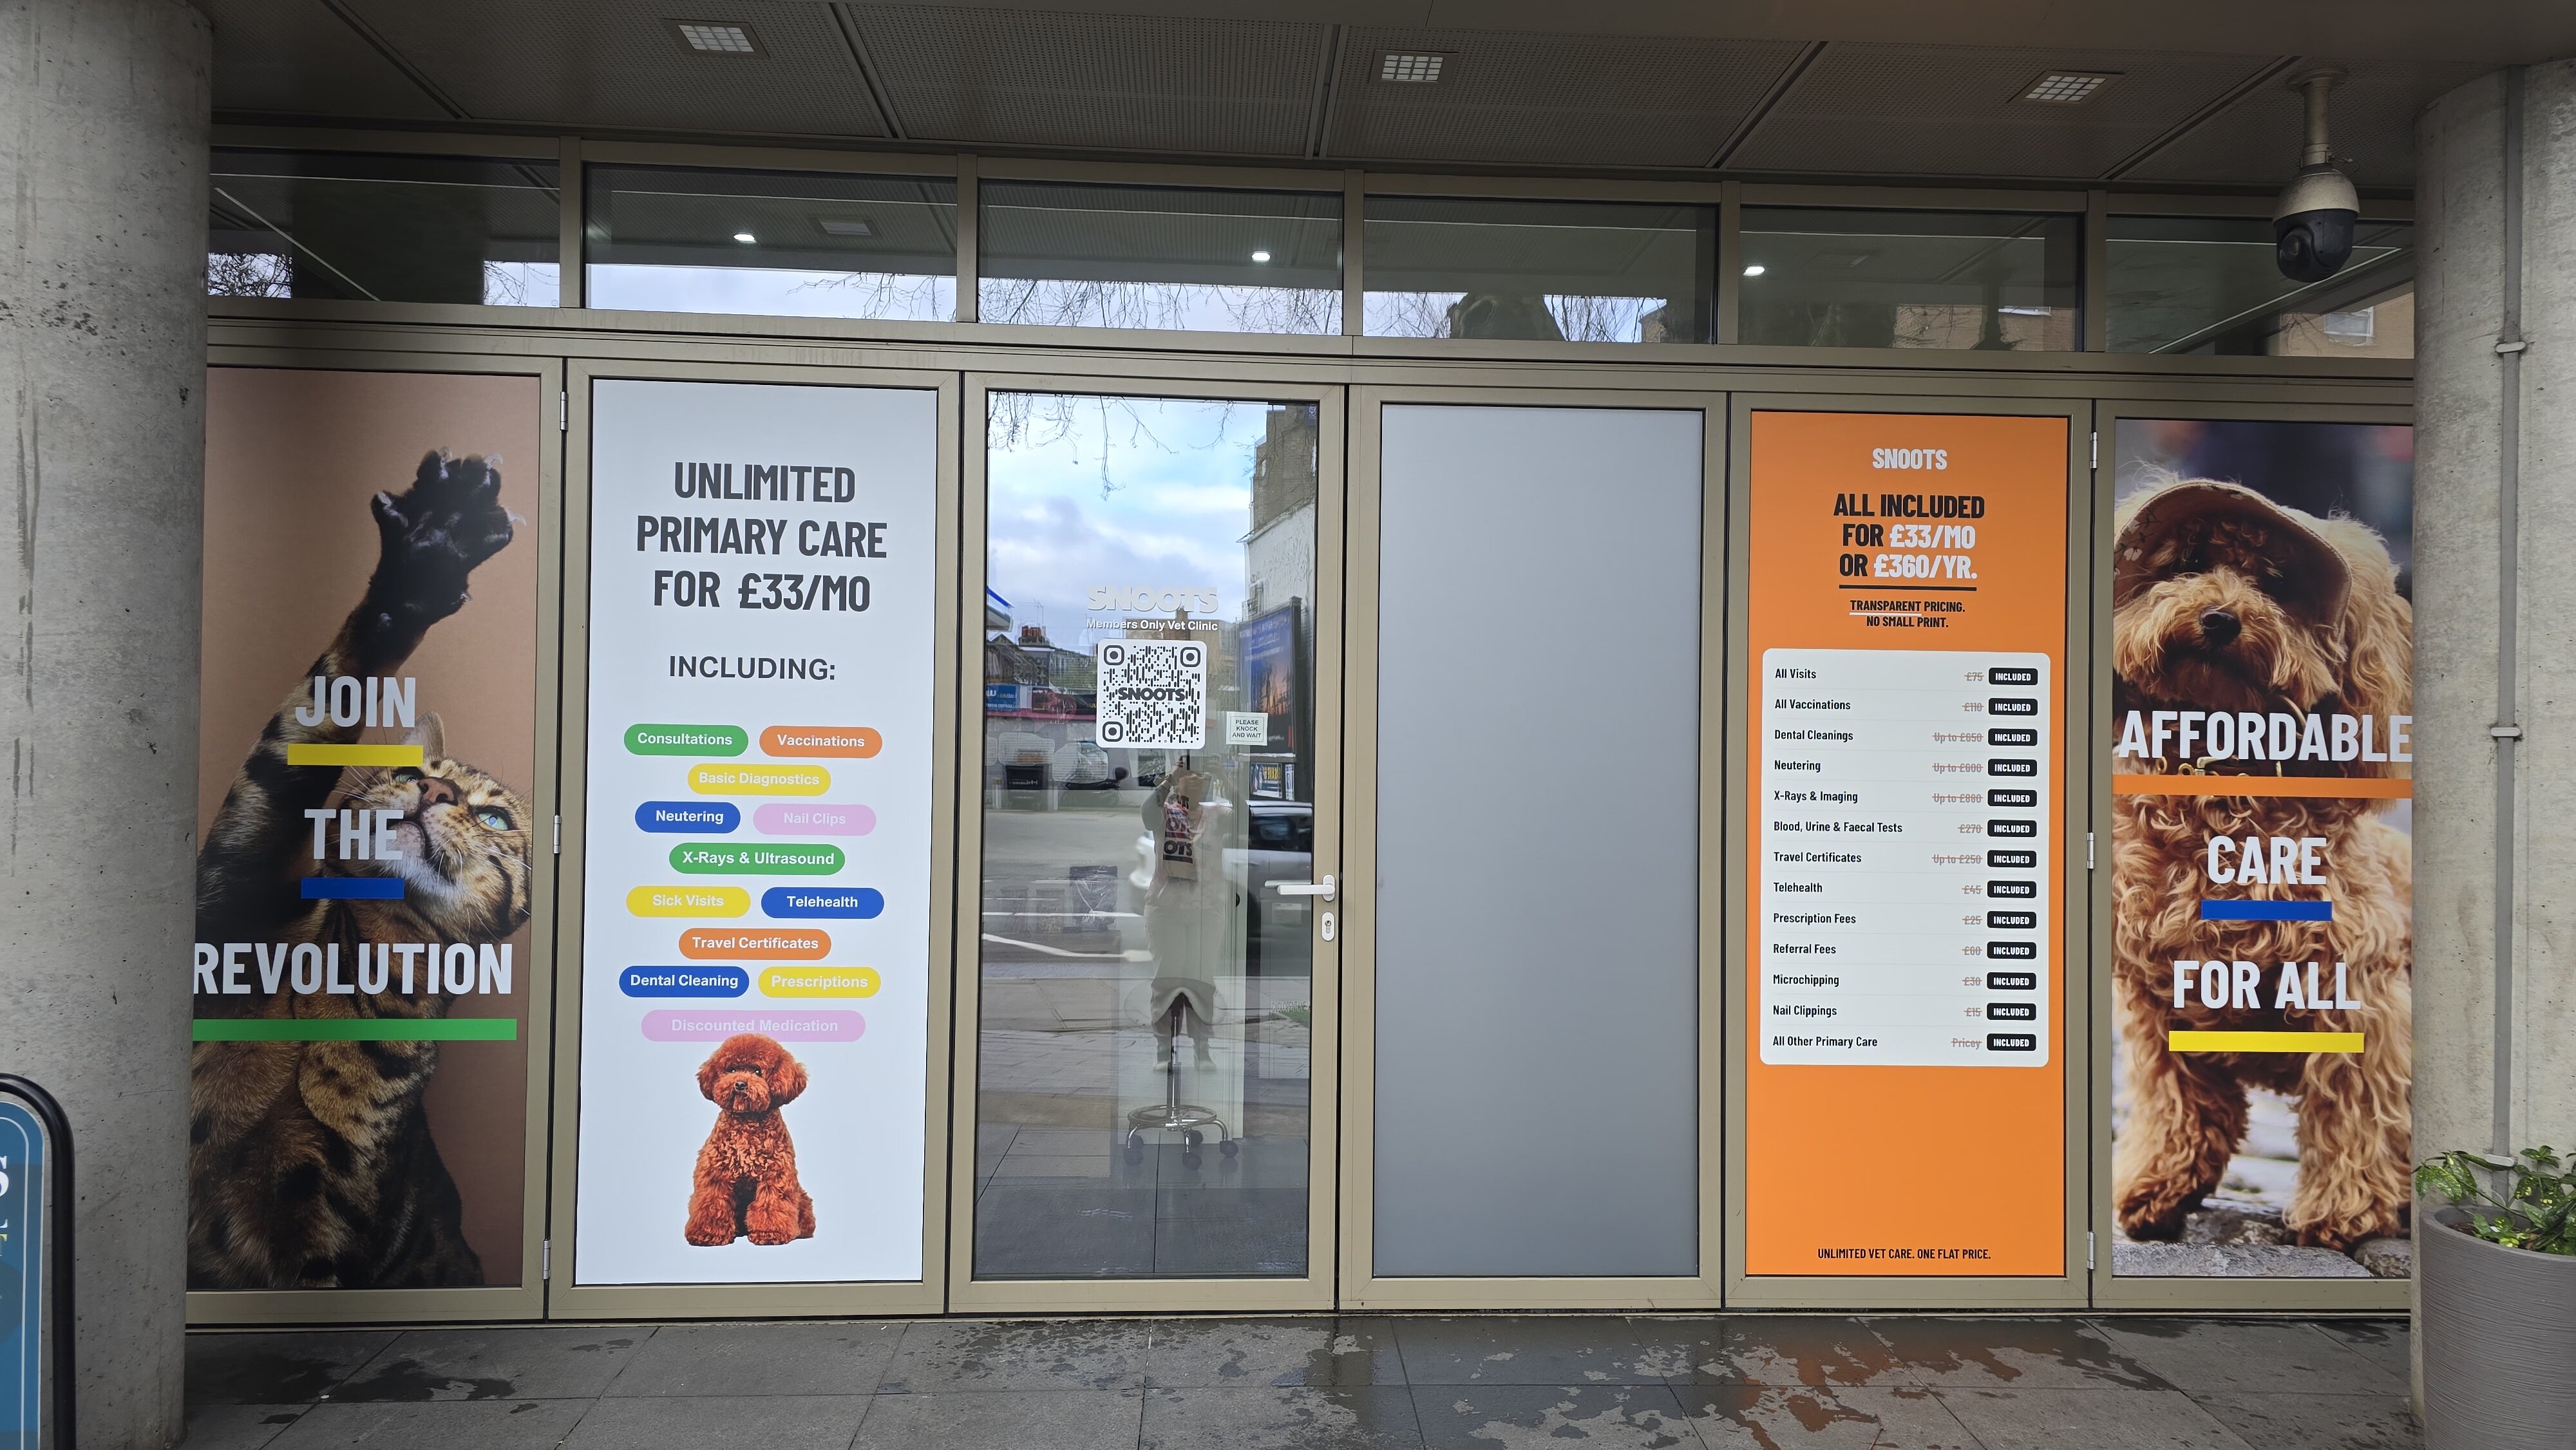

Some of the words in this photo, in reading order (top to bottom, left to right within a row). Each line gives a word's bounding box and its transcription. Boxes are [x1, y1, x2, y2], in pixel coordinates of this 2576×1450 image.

[1873, 448, 1947, 469] SNOOTS
[675, 462, 855, 503] UNLIMITED
[1833, 493, 1875, 516] ALL
[1880, 494, 1985, 518] INCLUDED
[637, 515, 788, 555] PRIMARY
[798, 520, 887, 558] CARE
[1842, 523, 1884, 547] FOR
[1889, 524, 1976, 549] £33/MO
[1839, 554, 1868, 576] OR
[1874, 554, 1977, 579] £360/YR.
[654, 570, 721, 608] FOR
[738, 572, 870, 612] £33/MO
[1088, 585, 1218, 613] SNOOTS
[1850, 599, 1922, 612] TRANSPARENT
[1924, 601, 1965, 613] PRICING.
[1086, 619, 1137, 629] Members
[1141, 620, 1165, 631] Only
[1168, 621, 1186, 630] Vet
[1188, 621, 1218, 630] Clinic
[1866, 616, 1880, 626] NO
[1882, 616, 1915, 627] SMALL
[1917, 617, 1949, 628] PRINT.
[669, 655, 836, 681] INCLUDING:
[1775, 669, 1787, 679] All
[1790, 669, 1817, 679] Visits
[1966, 672, 1982, 681] £75
[1995, 673, 2031, 681] INCLUDED
[1118, 688, 1186, 701] SNOOTS
[295, 676, 416, 728] JOIN
[1775, 699, 1787, 710] All
[1790, 700, 1851, 710] Vaccinations
[1964, 702, 1982, 711] £110
[1995, 703, 2031, 712] INCLUDED
[638, 733, 733, 746] Consultations
[777, 735, 865, 747] Vaccinations
[1774, 730, 1804, 740] Dental
[1807, 730, 1853, 742] Cleanings
[1934, 732, 1946, 743] Up
[1947, 733, 1957, 742] to
[1960, 733, 1982, 742] £650
[1994, 733, 2031, 742] INCLUDED
[2118, 710, 2412, 762] AFFORDABLE
[1774, 760, 1821, 772] Neutering
[1933, 763, 1945, 774] Up
[1947, 763, 1957, 772] to
[1994, 764, 2031, 773] INCLUDED
[699, 772, 735, 784] Basic
[739, 773, 820, 786] Diagnostics
[1774, 791, 1807, 802] X-Rays
[1810, 791, 1817, 802] &
[1820, 791, 1858, 803] Imaging
[1933, 793, 1945, 804] Up
[1947, 794, 1956, 803] to
[1994, 794, 2031, 803] INCLUDED
[656, 810, 724, 825] Neutering
[784, 813, 809, 824] Nail
[812, 813, 846, 826] Clips
[1774, 822, 1803, 833] Blood,
[1806, 822, 1831, 833] Urine
[1833, 822, 1841, 832] &
[1844, 822, 1875, 833] Faecal
[1877, 823, 1902, 833] Tests
[1959, 824, 1982, 834] £270
[1994, 824, 2031, 833] INCLUDED
[304, 809, 404, 860] THE
[683, 851, 734, 866] X-Rays
[739, 852, 750, 863] &
[755, 852, 835, 865] Ultrasound
[1774, 852, 1803, 862] Travel
[1806, 852, 1862, 863] Certificates
[1933, 854, 1945, 865] Up
[1947, 854, 1956, 863] to
[1959, 854, 1981, 864] £250
[1994, 855, 2030, 864] INCLUDED
[2208, 835, 2327, 885] CARE
[1774, 882, 1823, 893] Telehealth
[1964, 885, 1981, 894] £45
[1993, 885, 2030, 894] INCLUDED
[652, 894, 682, 907] Sick
[686, 895, 724, 907] Visits
[787, 896, 858, 908] Telehealth
[1774, 913, 1832, 925] Prescription
[1835, 914, 1856, 924] Fees
[1964, 916, 1982, 925] £25
[1993, 916, 2030, 925] INCLUDED
[692, 937, 735, 948] Travel
[739, 937, 819, 950] Certificates
[1774, 943, 1812, 954] Referral
[1814, 944, 1837, 954] Fees
[1964, 946, 1981, 956] £60
[1993, 946, 2030, 956] INCLUDED
[194, 943, 513, 995] REVOLUTION
[630, 975, 675, 986] Dental
[678, 975, 739, 989] Cleaning
[772, 975, 868, 990] Prescriptions
[1773, 974, 1839, 986] Microchipping
[1964, 977, 1981, 986] £30
[1993, 977, 2030, 986] INCLUDED
[2174, 961, 2260, 1009] FOR
[2275, 961, 2361, 1010] ALL
[1773, 1005, 1791, 1015] Nail
[1794, 1005, 1837, 1017] Clippings
[1966, 1008, 1981, 1017] £15
[1993, 1008, 2030, 1017] INCLUDED
[672, 1019, 755, 1031] Discounted
[759, 1021, 838, 1031] Medication
[1773, 1036, 1785, 1046] All
[1787, 1036, 1814, 1046] Other
[1816, 1037, 1853, 1049] Primary
[1856, 1037, 1878, 1047] Care
[1953, 1038, 1980, 1050] Pricey
[1993, 1038, 2030, 1047] INCLUDED
[1818, 1248, 1866, 1258] UNLIMITED
[1868, 1248, 1886, 1259] VET
[1888, 1249, 1915, 1259] CARE.
[1917, 1249, 1935, 1259] ONE
[1938, 1249, 1960, 1259] FLAT
[1962, 1249, 1991, 1259] PRICE.
